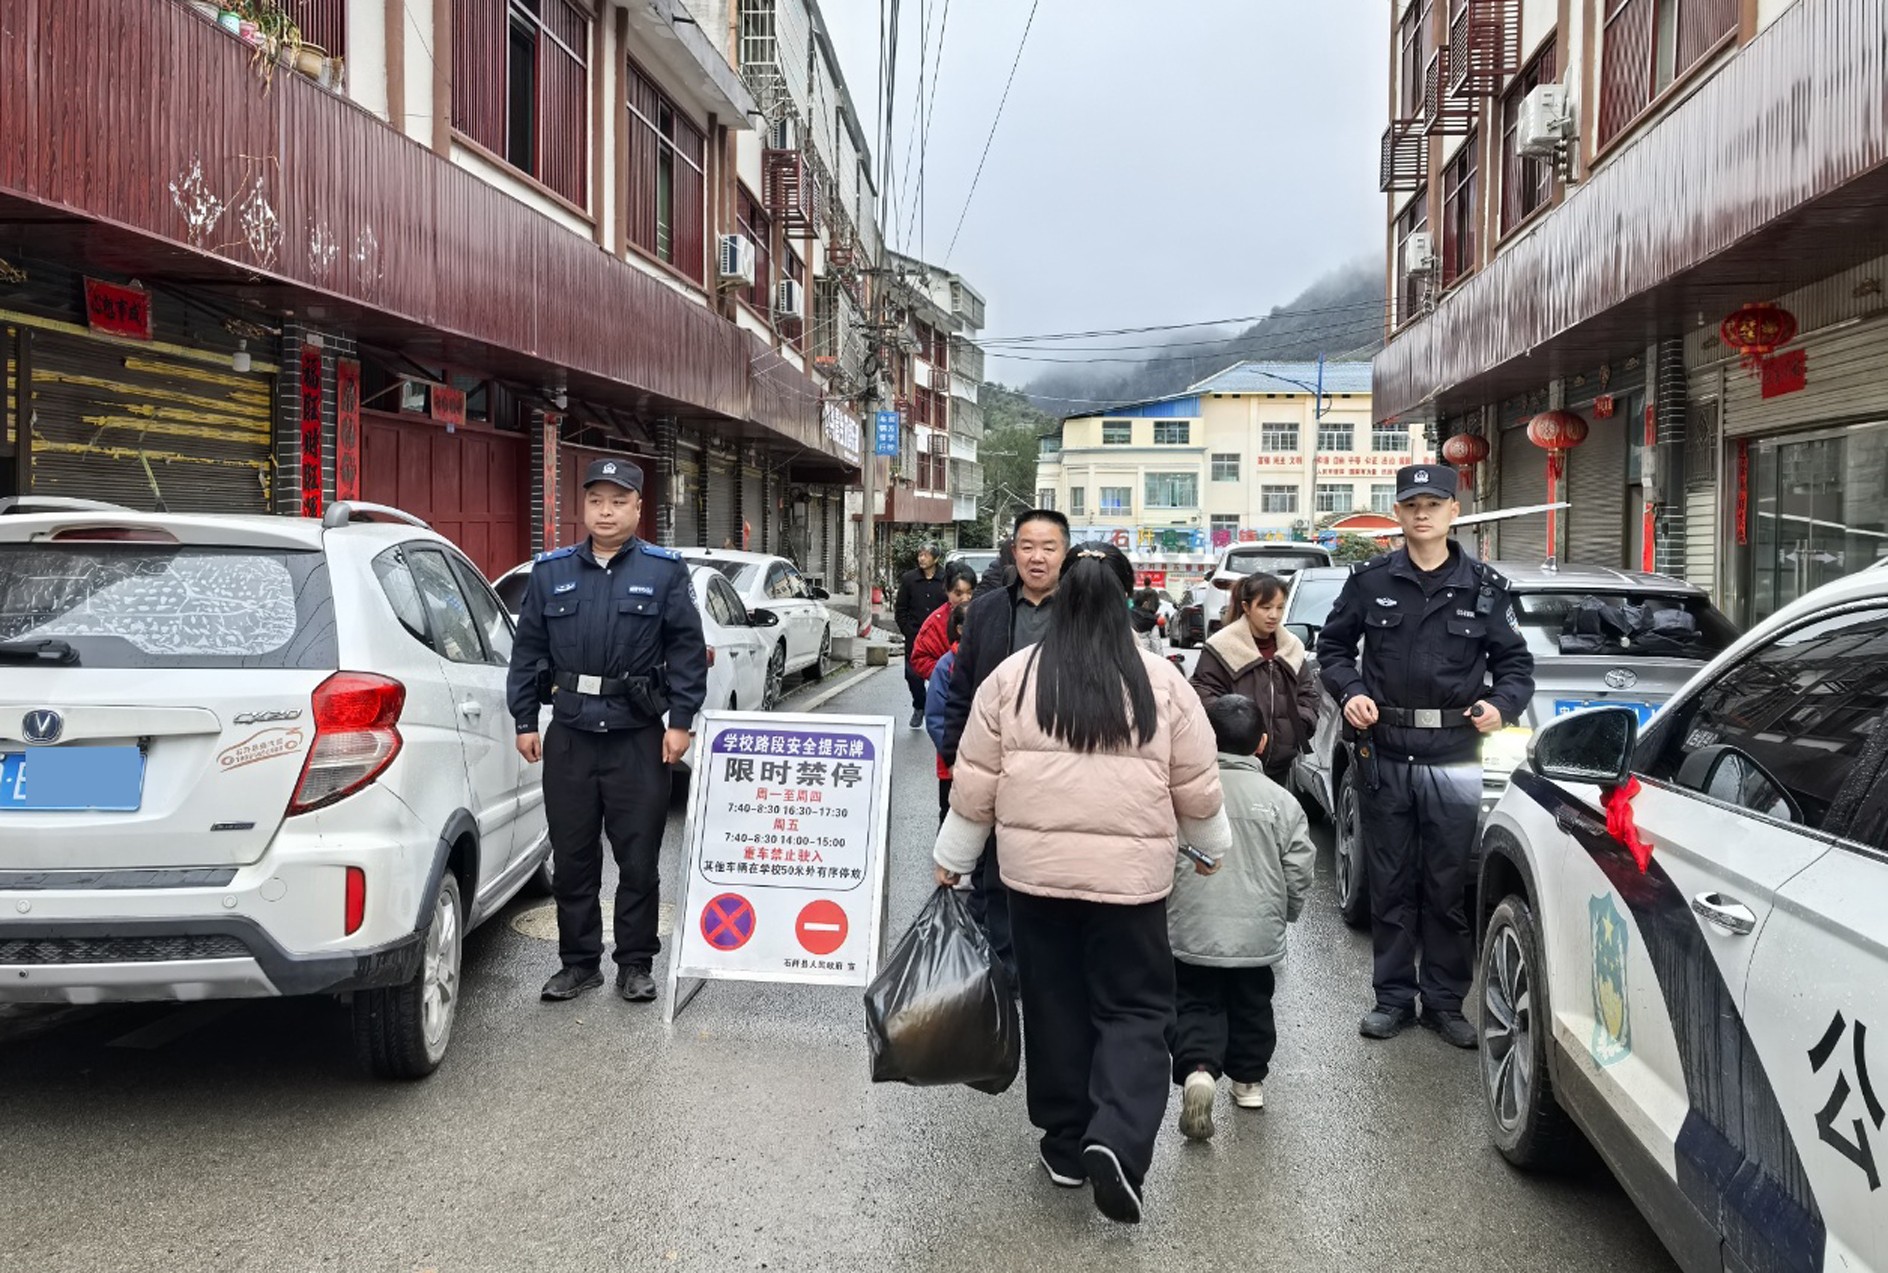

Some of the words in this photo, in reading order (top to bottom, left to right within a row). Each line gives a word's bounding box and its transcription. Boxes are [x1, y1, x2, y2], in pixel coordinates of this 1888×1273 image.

[723, 733, 864, 758] 学校路段安全提示牌
[724, 757, 863, 788] 限时禁停
[755, 787, 822, 803] 周一至周四
[728, 803, 780, 815] 7:40-8:30
[783, 805, 848, 818] 16:30-17:30
[773, 818, 799, 832] 周五
[725, 832, 777, 844] 7:40-8:30
[781, 835, 846, 848] 14:00-15:00
[743, 846, 823, 863] 重车禁止驶入
[703, 860, 862, 880] 其他车辆在学校50米外有序停放
[1807, 1009, 1886, 1192] 公
